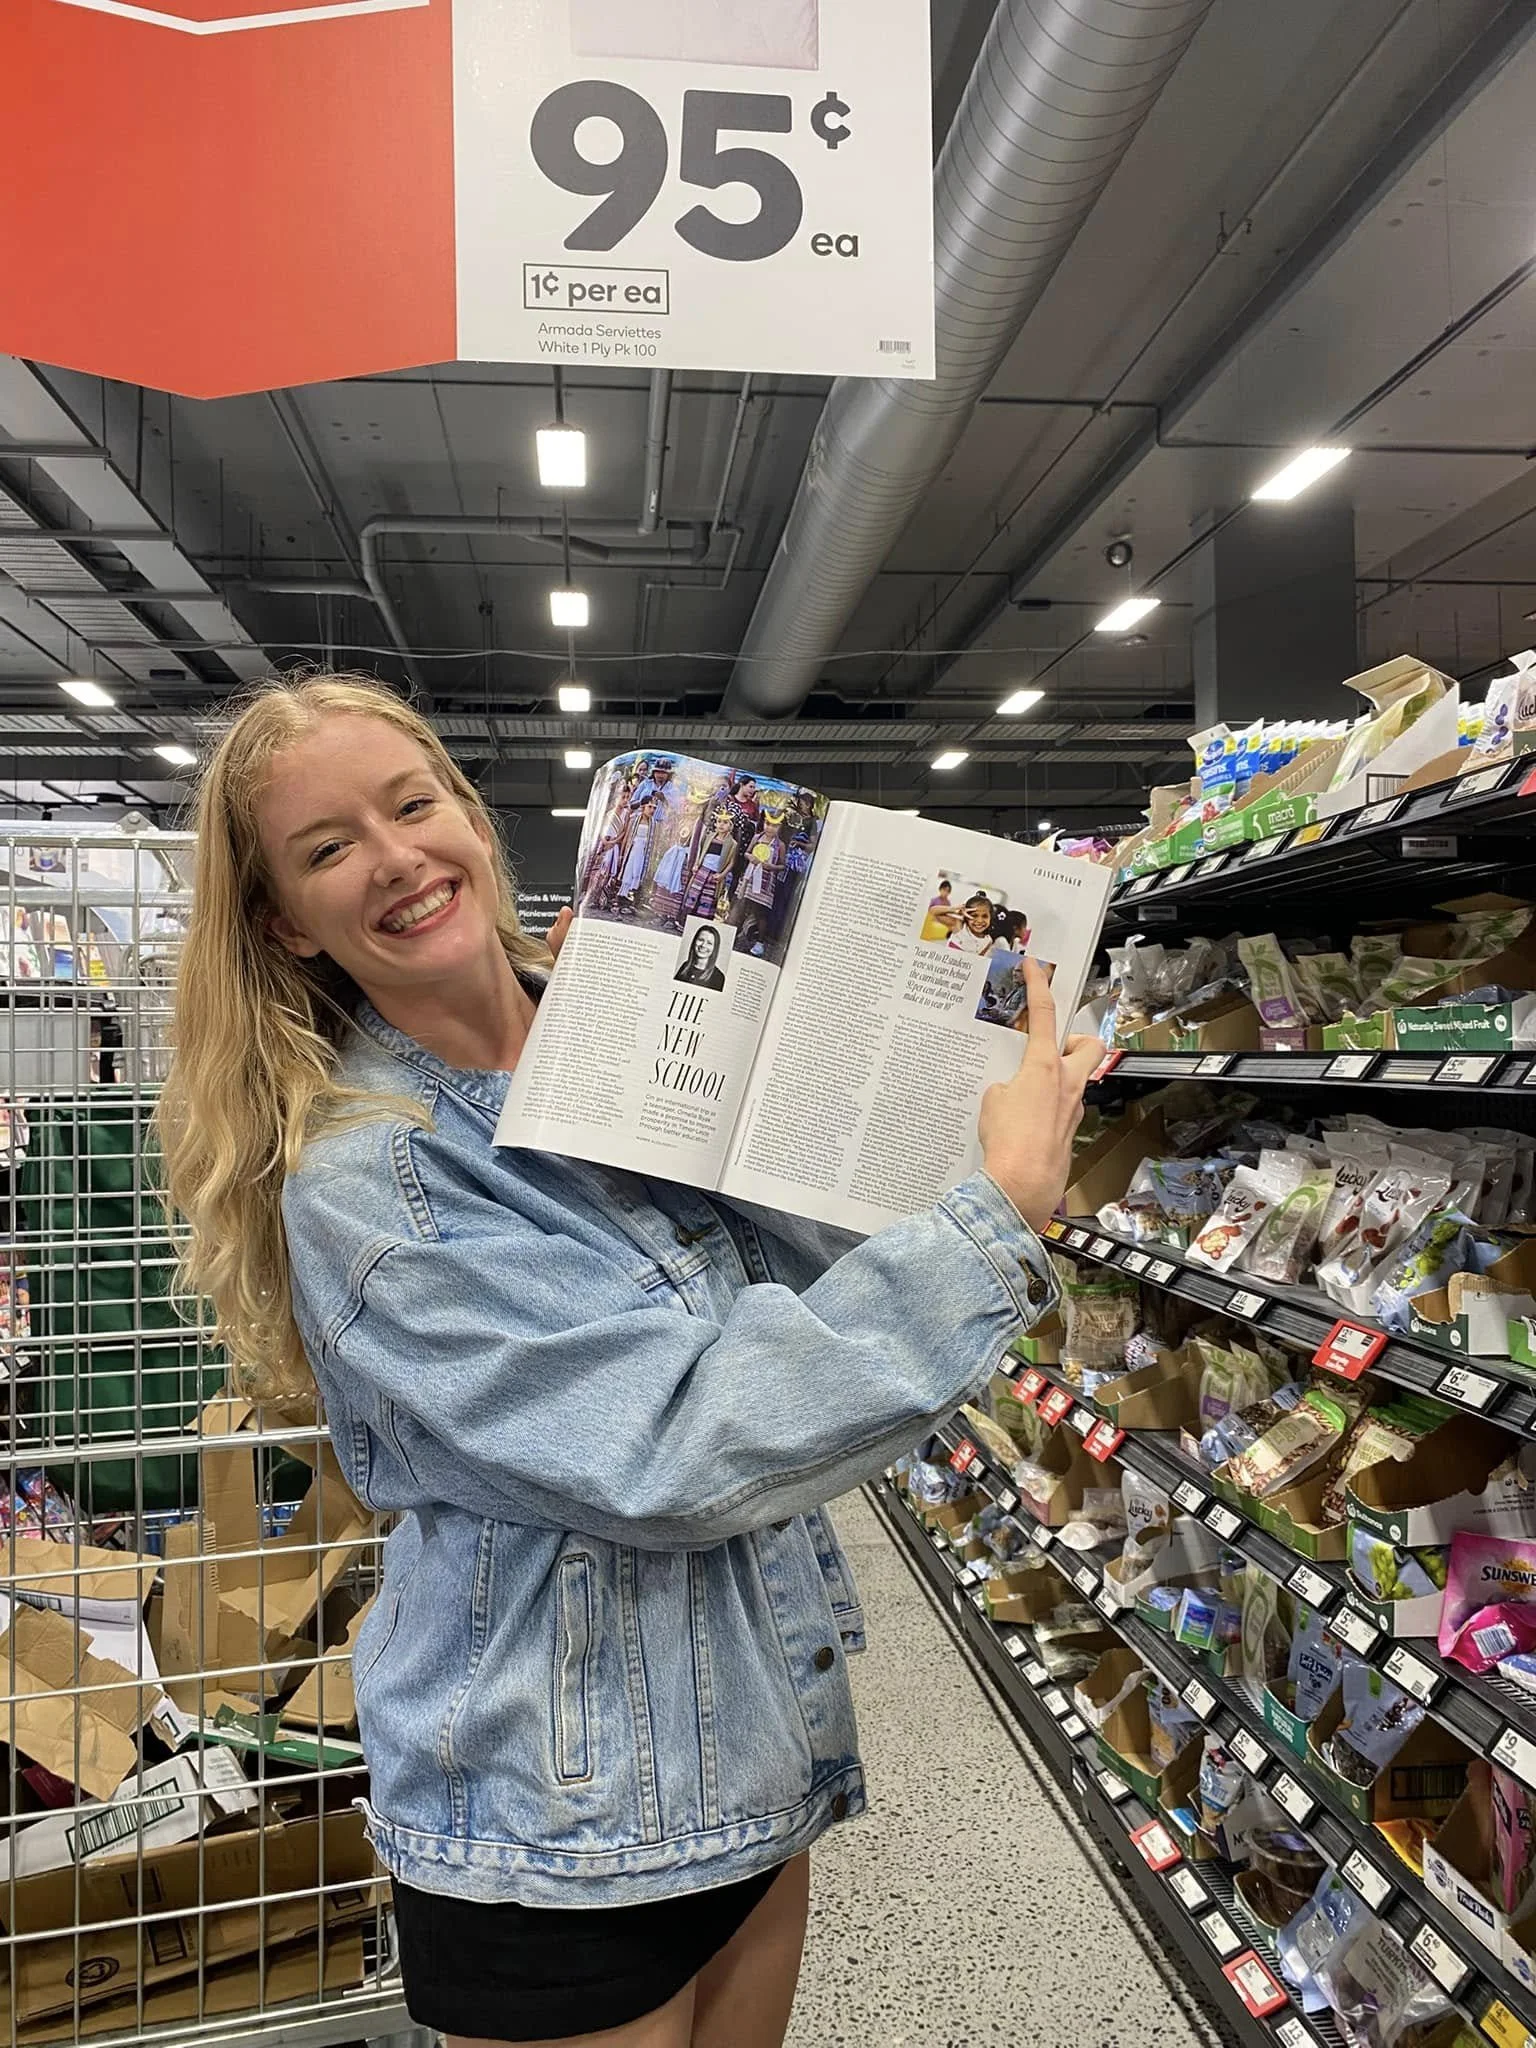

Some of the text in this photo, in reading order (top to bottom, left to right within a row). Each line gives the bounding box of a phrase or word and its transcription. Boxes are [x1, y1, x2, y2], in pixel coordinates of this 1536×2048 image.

[811, 231, 859, 257] ea
[530, 272, 661, 307] 1¢ per ea
[538, 322, 662, 339] Armada Serviettes
[539, 340, 657, 358] White 1 Ply Pk 100
[542, 894, 549, 902] &
[550, 894, 572, 903] Wrap
[667, 990, 709, 1026] THE
[1474, 1020, 1490, 1030] Fruit
[656, 1024, 705, 1059] NEW
[648, 1057, 726, 1102] SCHOOL
